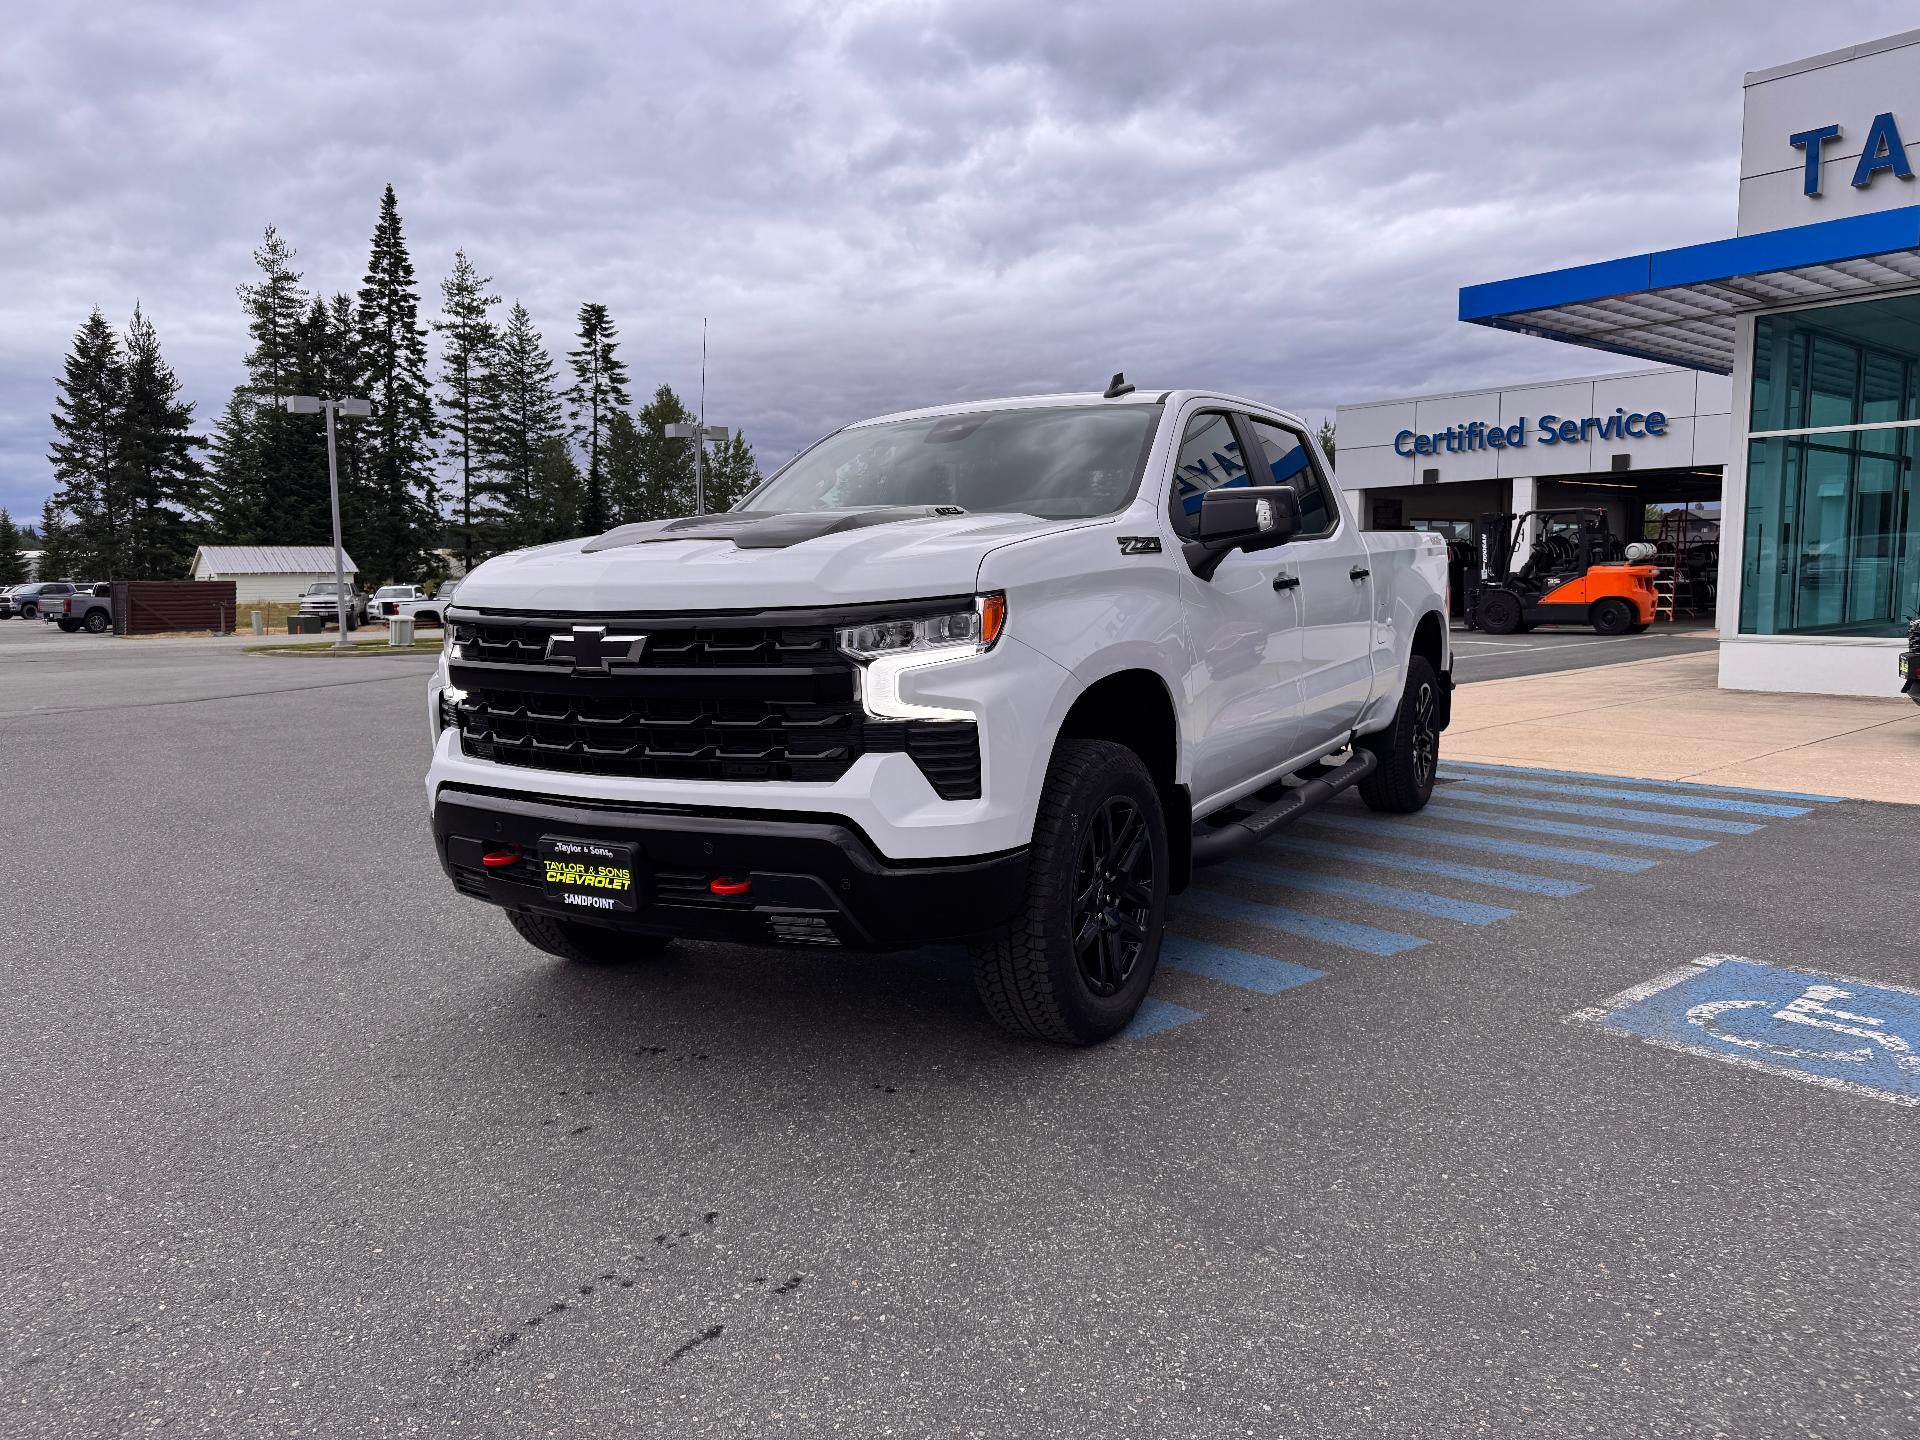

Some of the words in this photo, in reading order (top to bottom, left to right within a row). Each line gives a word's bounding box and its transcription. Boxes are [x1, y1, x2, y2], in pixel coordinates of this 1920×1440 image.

[1394, 416, 1526, 457] Certified
[1537, 407, 1666, 445] Service
[557, 842, 582, 854] Taylor
[590, 846, 609, 856] Sons
[544, 860, 585, 873] TAYLOR
[588, 865, 596, 876] &
[598, 866, 630, 879] SONS
[546, 871, 631, 891] CHEVROLET
[563, 893, 615, 910] SANDPOINT
